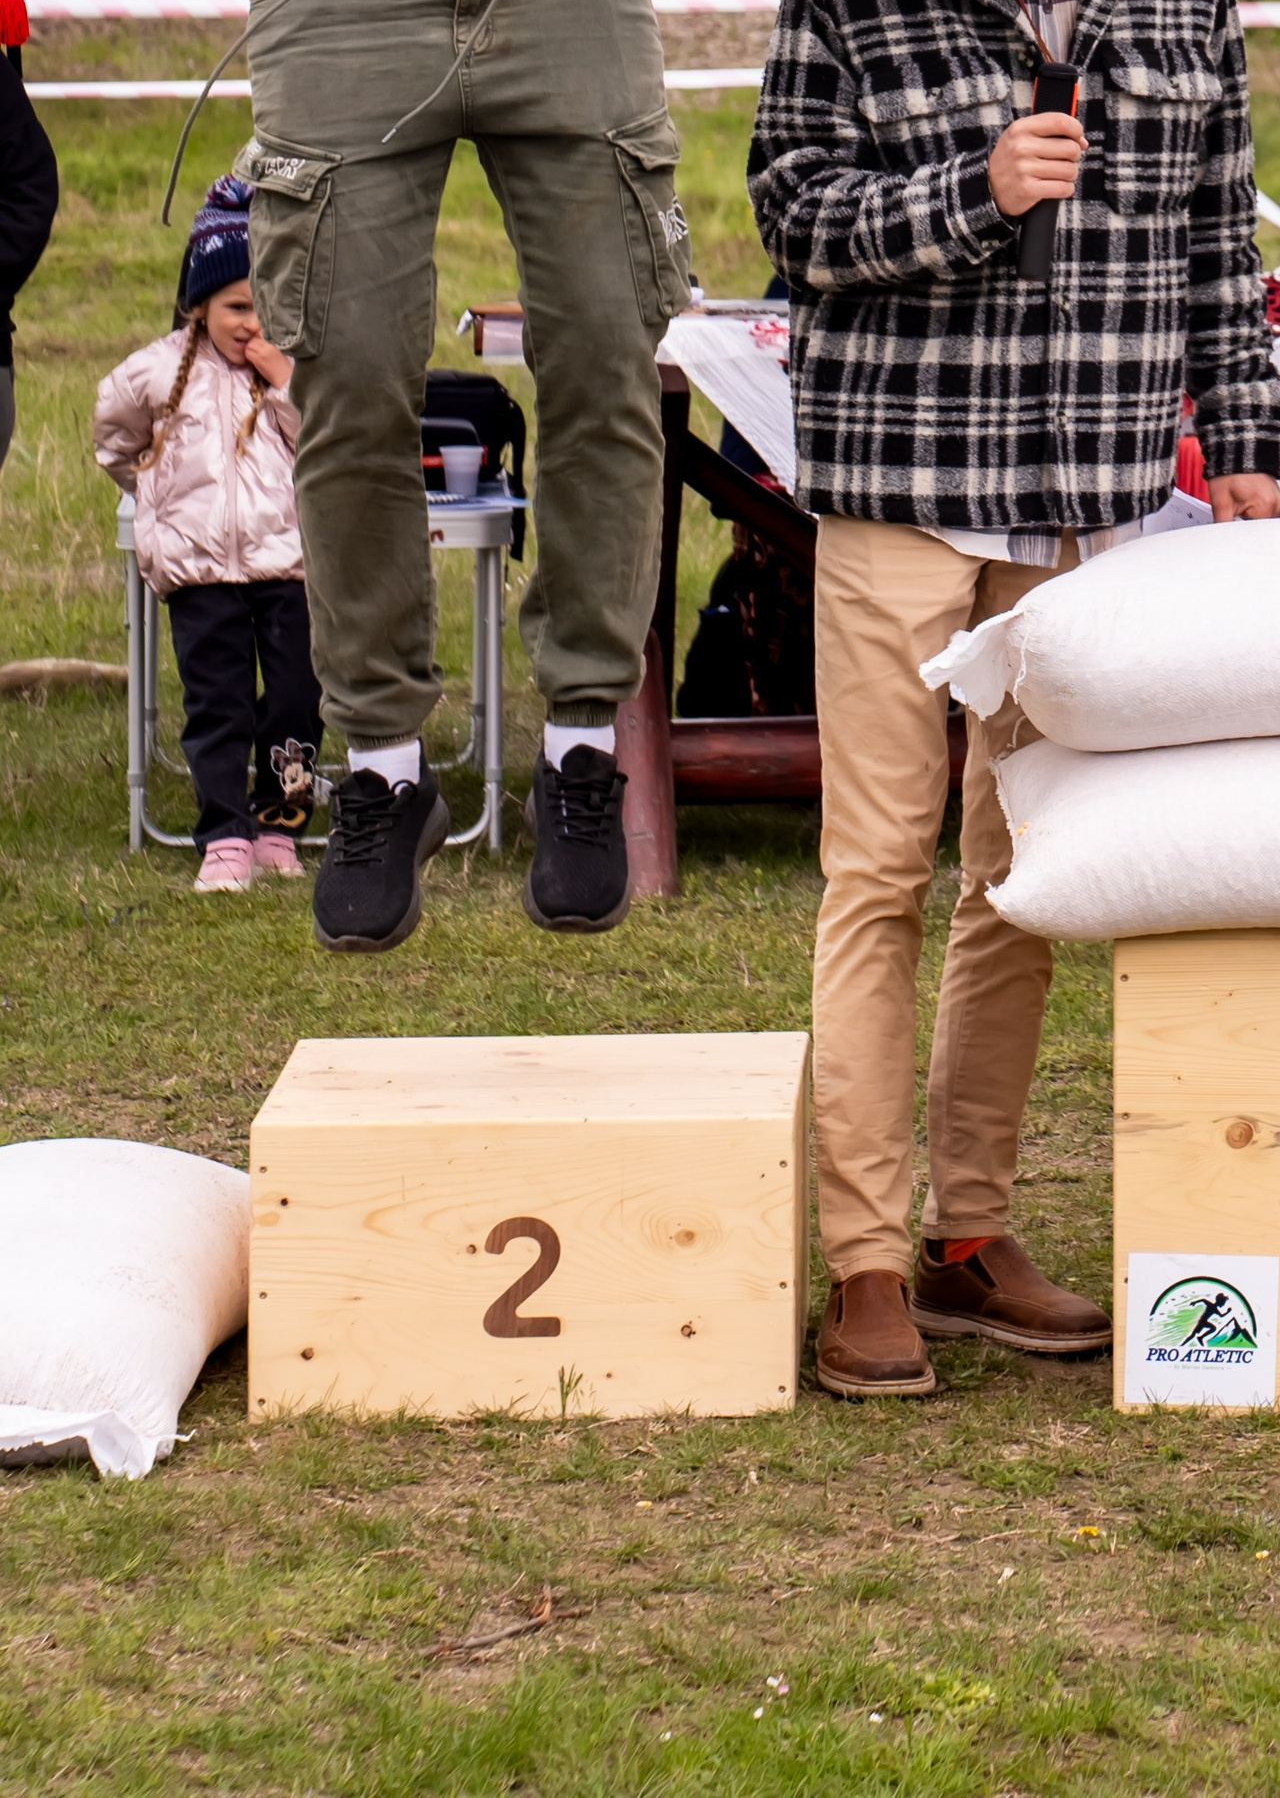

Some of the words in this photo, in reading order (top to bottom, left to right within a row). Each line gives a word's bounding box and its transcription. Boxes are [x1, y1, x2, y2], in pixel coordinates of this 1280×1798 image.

[483, 1216, 561, 1338] 2
[1146, 1347, 1179, 1362] PRO
[1180, 1348, 1254, 1364] ATLETIC
